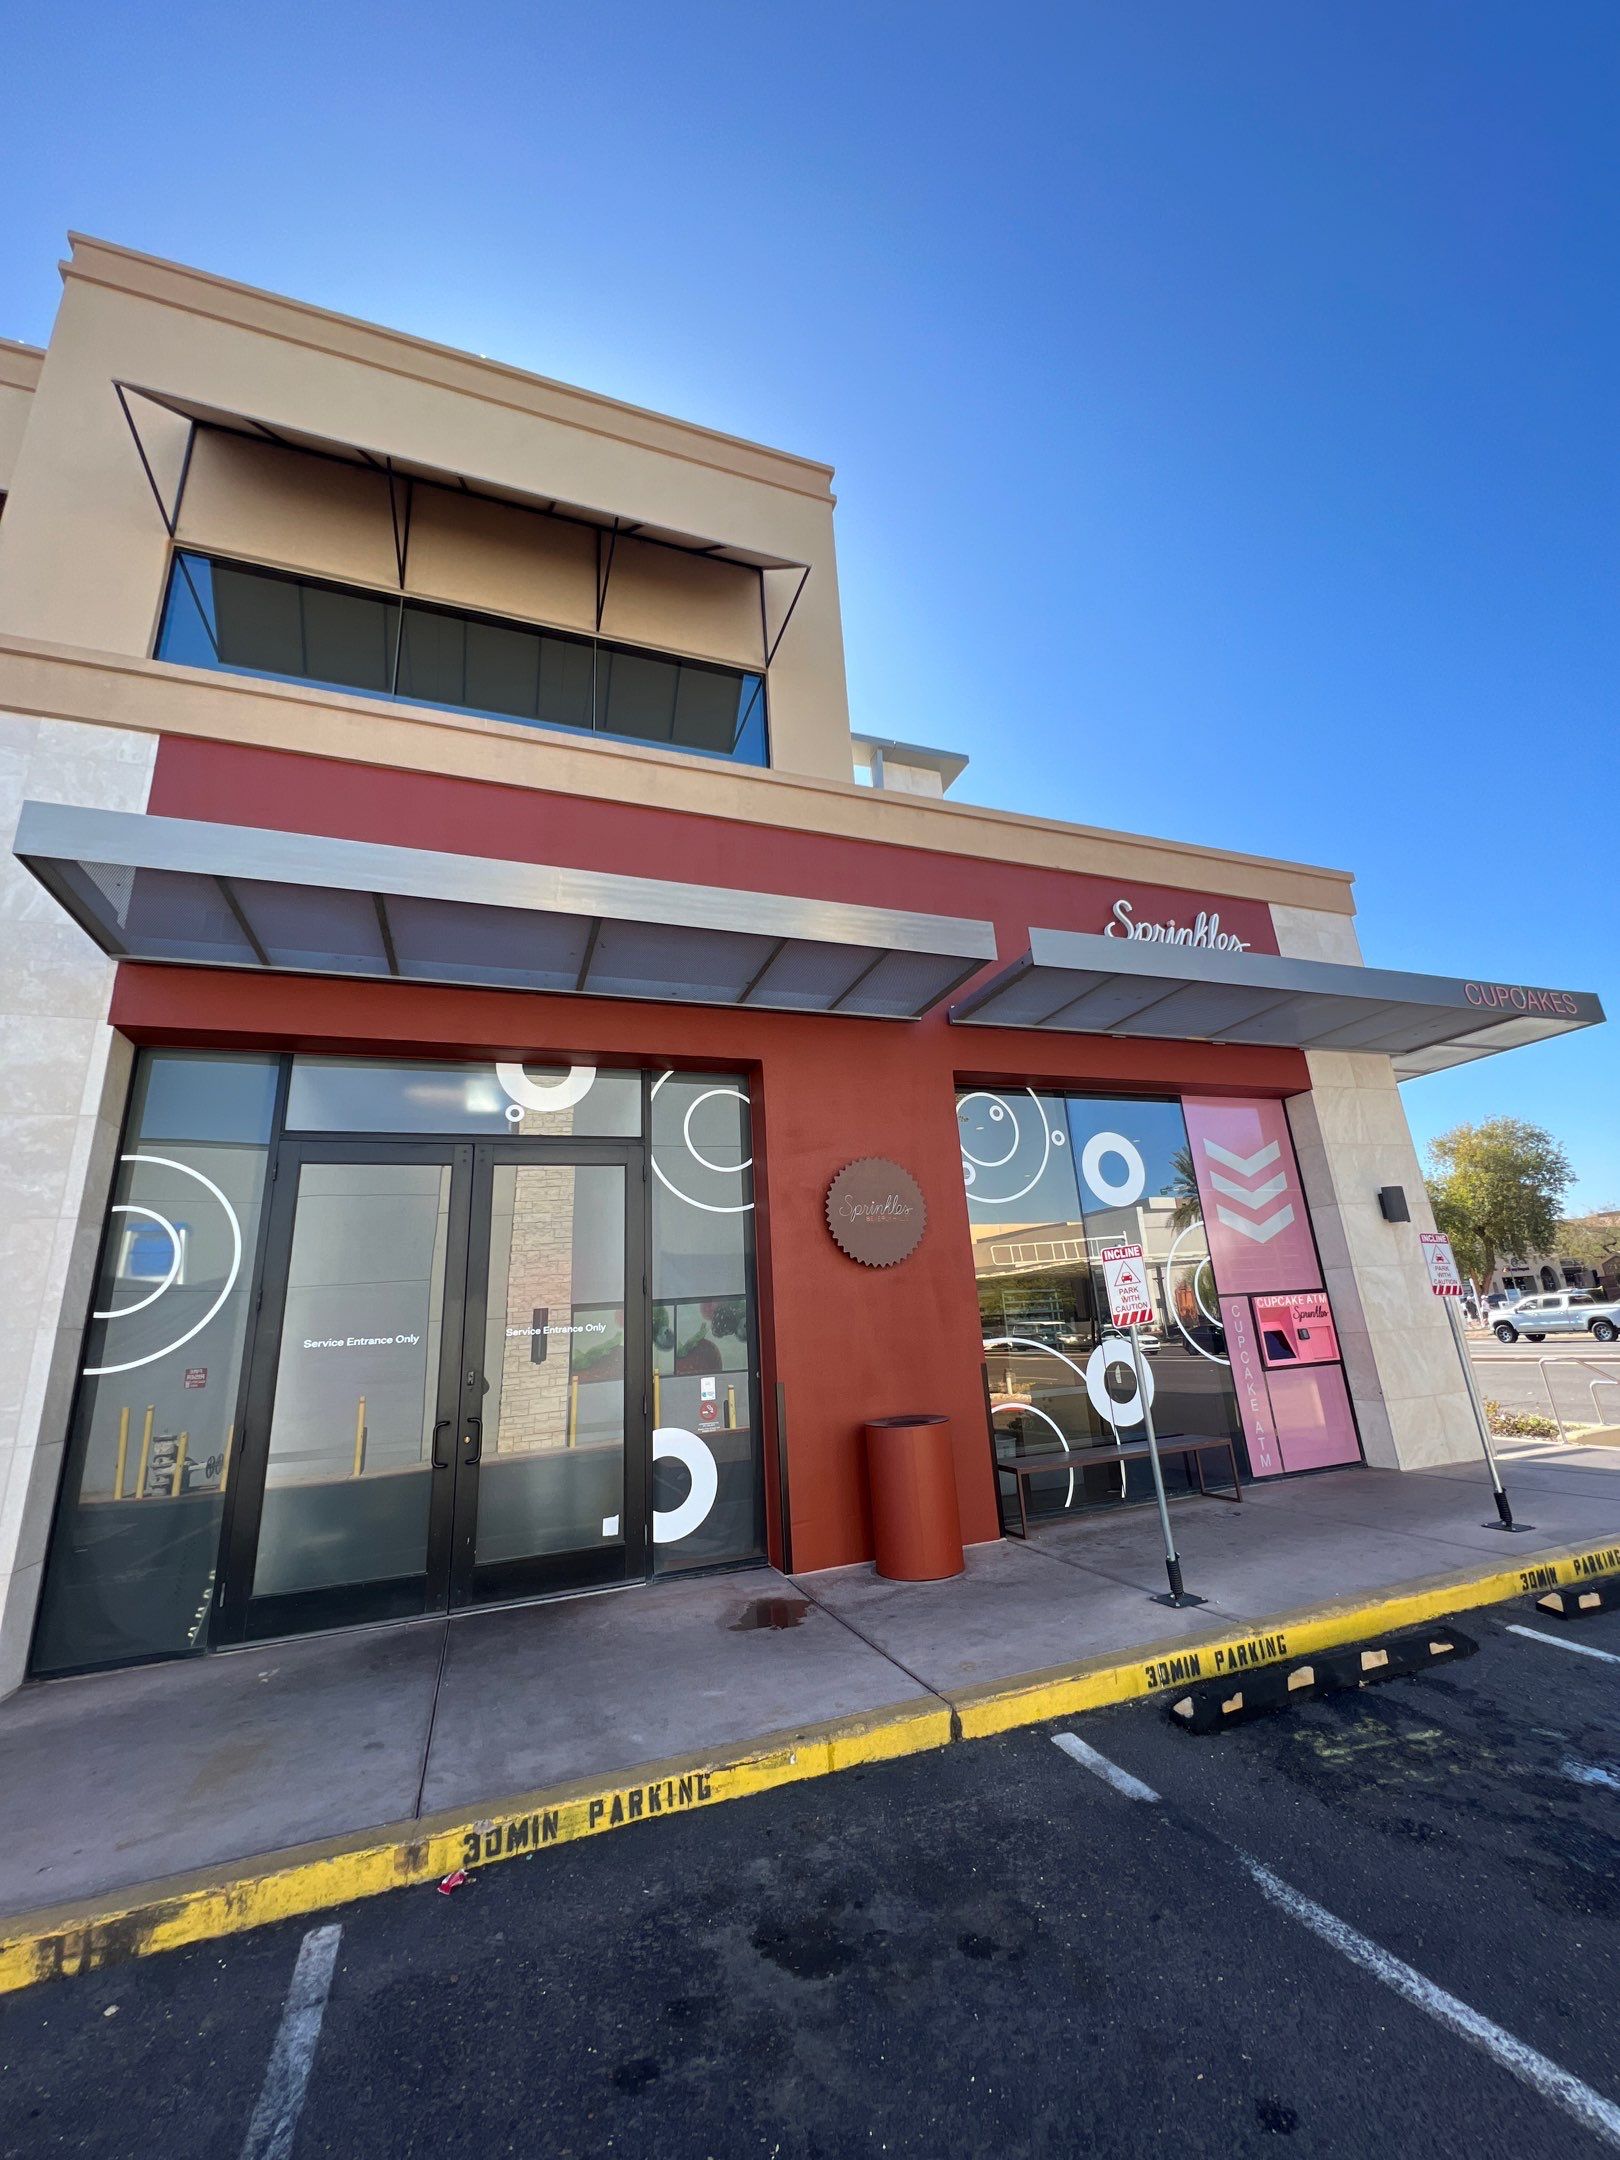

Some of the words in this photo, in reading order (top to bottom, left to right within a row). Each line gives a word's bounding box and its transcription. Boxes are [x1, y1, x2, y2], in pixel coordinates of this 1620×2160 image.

[1104, 900, 1250, 952] Sprinkles
[1464, 983, 1578, 1015] CUPCAKES
[838, 1194, 914, 1223] Sprinkles
[1103, 1246, 1141, 1261] INCLINE
[1118, 1286, 1139, 1295] PARK
[1121, 1295, 1141, 1303] WITH
[1256, 1296, 1305, 1308] CUPCAKE
[1306, 1293, 1328, 1305] ATM
[1115, 1301, 1149, 1313] CAUTION
[505, 1326, 542, 1337] Service
[542, 1325, 584, 1335] Entrance
[585, 1323, 607, 1334] Only
[303, 1338, 345, 1349] Service
[346, 1337, 394, 1347] Entrance
[395, 1333, 421, 1346] Only
[1231, 1304, 1260, 1413] CUPCAKE
[1255, 1420, 1272, 1469] ATM
[1520, 1565, 1558, 1591] 30MIN
[1145, 1653, 1201, 1688] 30MIN
[1214, 1634, 1288, 1672] PARKING
[463, 1810, 559, 1865] 30MIN
[589, 1773, 712, 1829] PARKING
